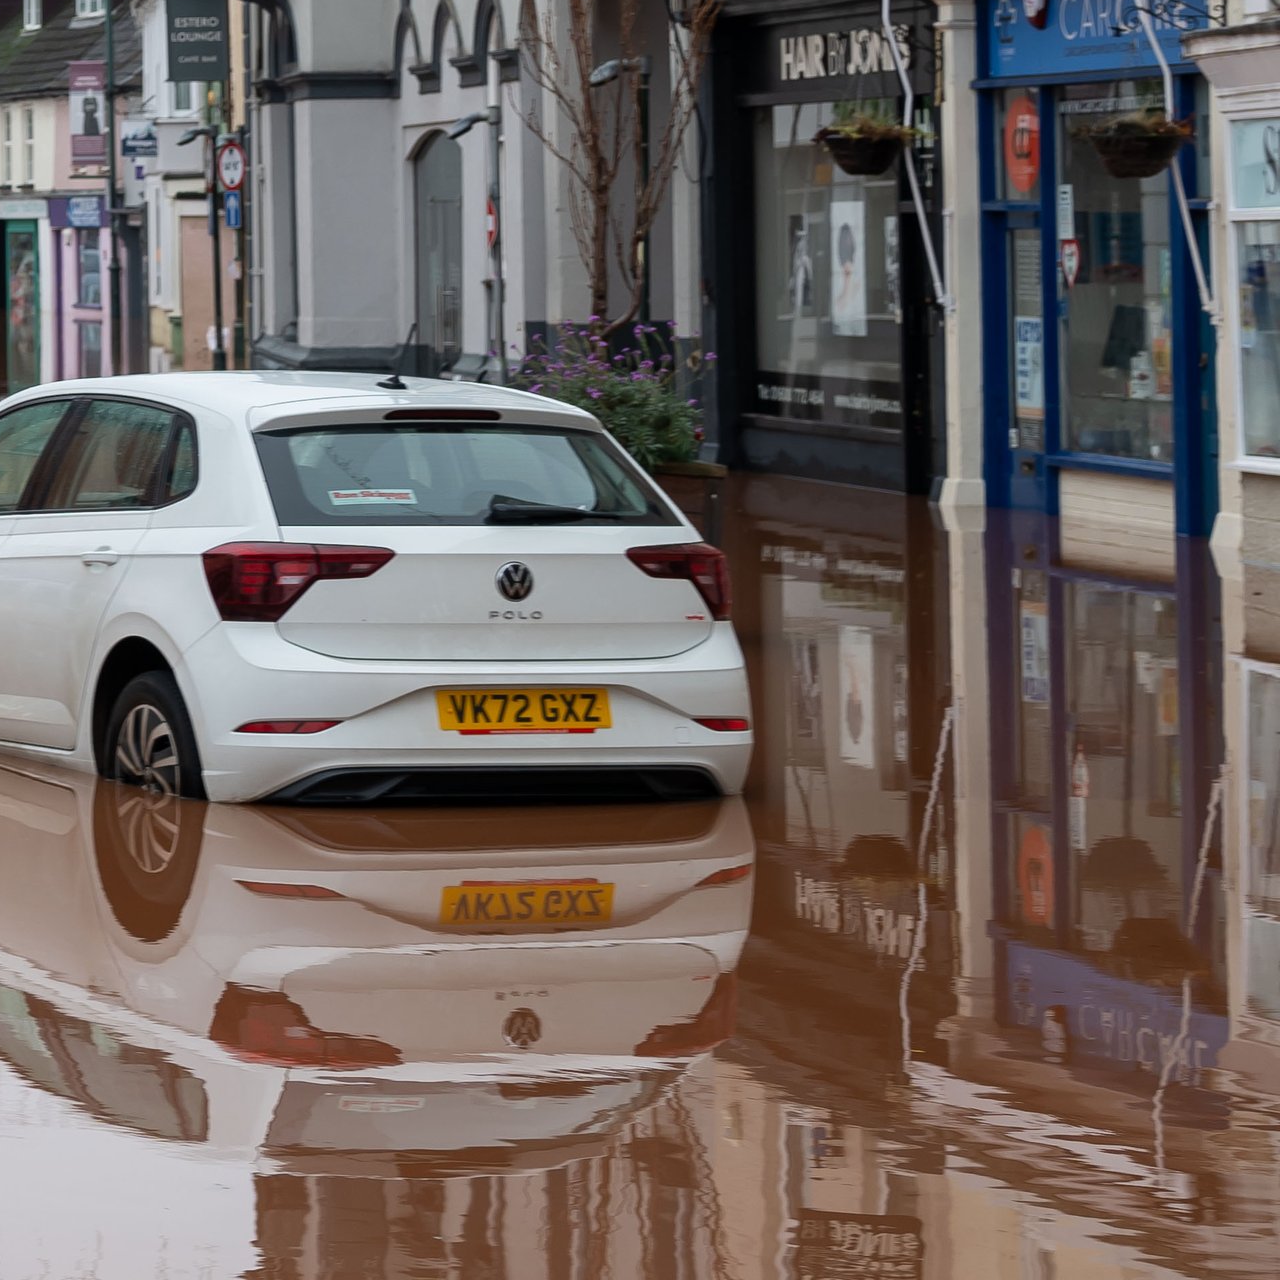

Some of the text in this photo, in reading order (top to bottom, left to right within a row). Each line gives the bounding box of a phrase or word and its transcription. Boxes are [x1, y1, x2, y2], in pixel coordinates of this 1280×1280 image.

[174, 16, 219, 28] ESTERO
[170, 31, 223, 42] LOUNGE
[780, 34, 826, 80] HAIR
[488, 610, 543, 620] POLO
[449, 692, 602, 724] VK72 GXZ
